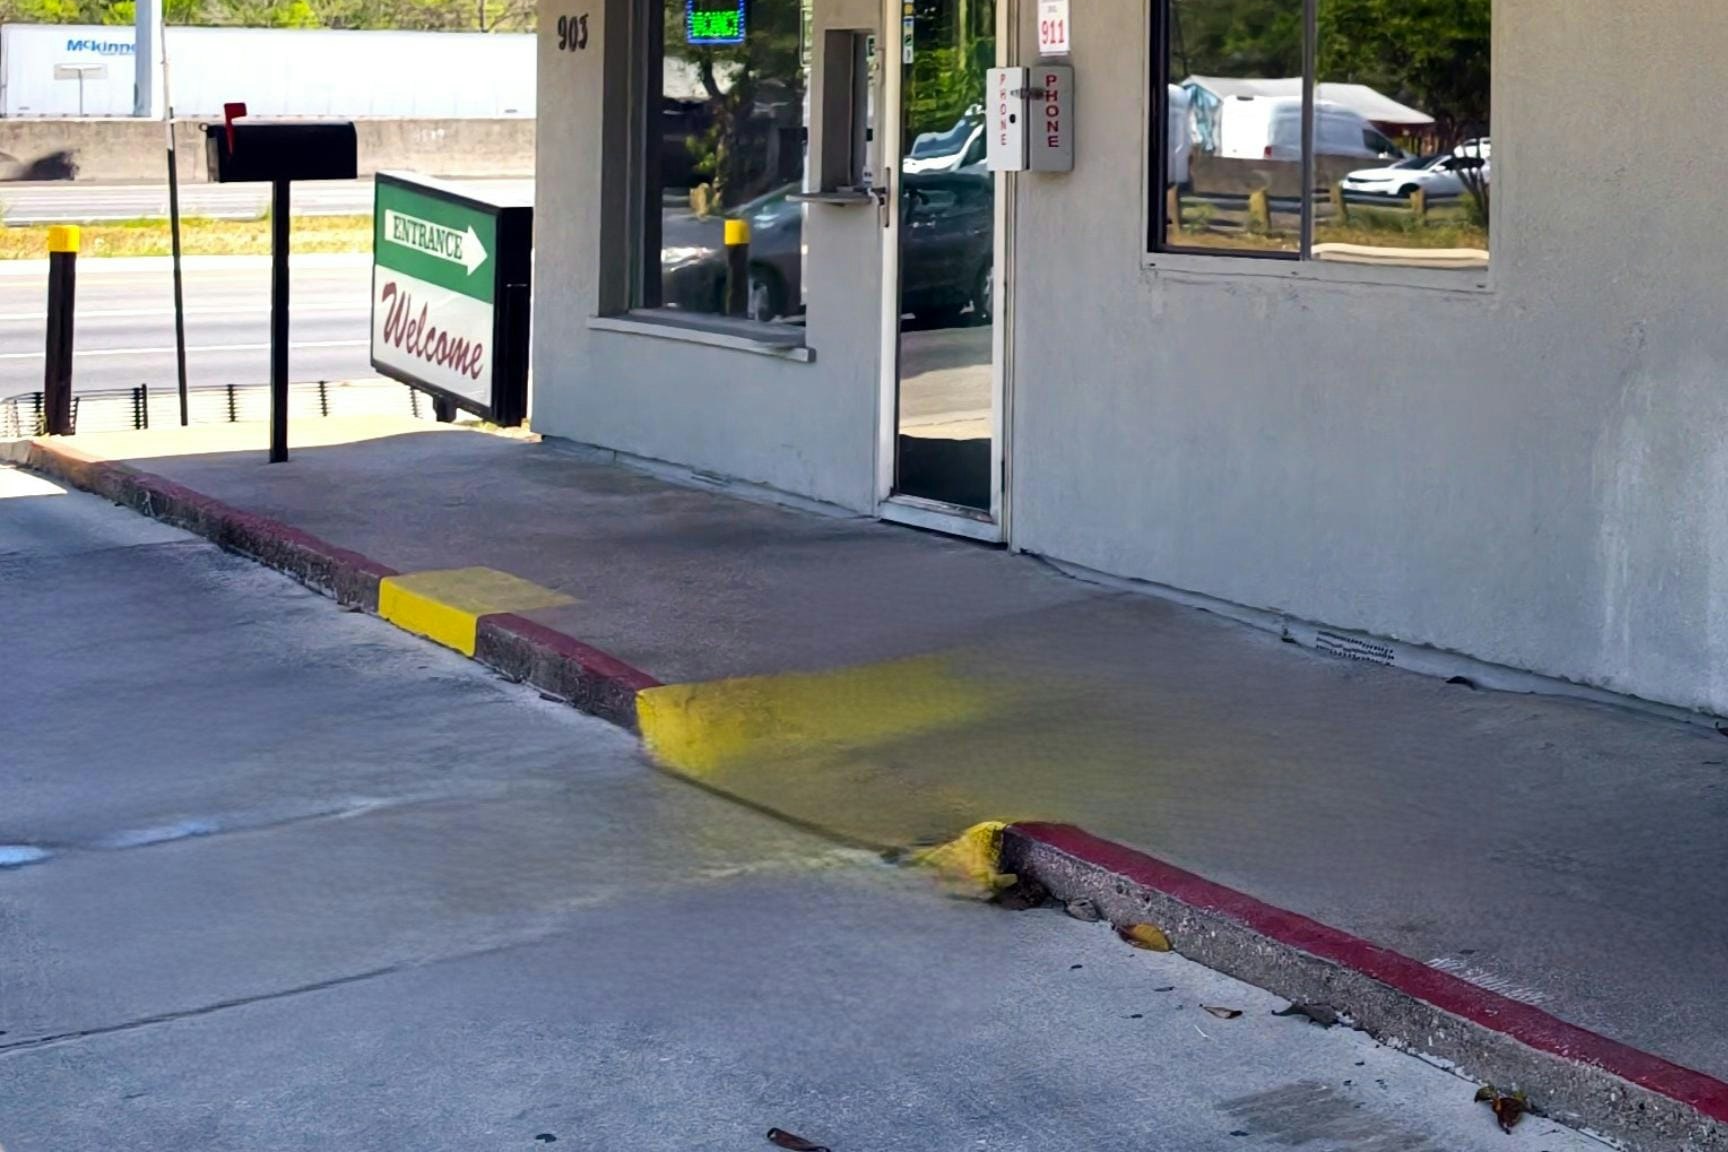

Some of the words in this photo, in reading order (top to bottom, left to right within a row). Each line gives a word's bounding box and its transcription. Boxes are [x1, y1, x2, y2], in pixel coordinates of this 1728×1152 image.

[1041, 18, 1065, 45] 911
[999, 73, 1007, 146] PHONE
[1045, 74, 1060, 148] PHONE
[392, 214, 464, 260] ENTRANCE
[381, 281, 485, 380] Welcome
